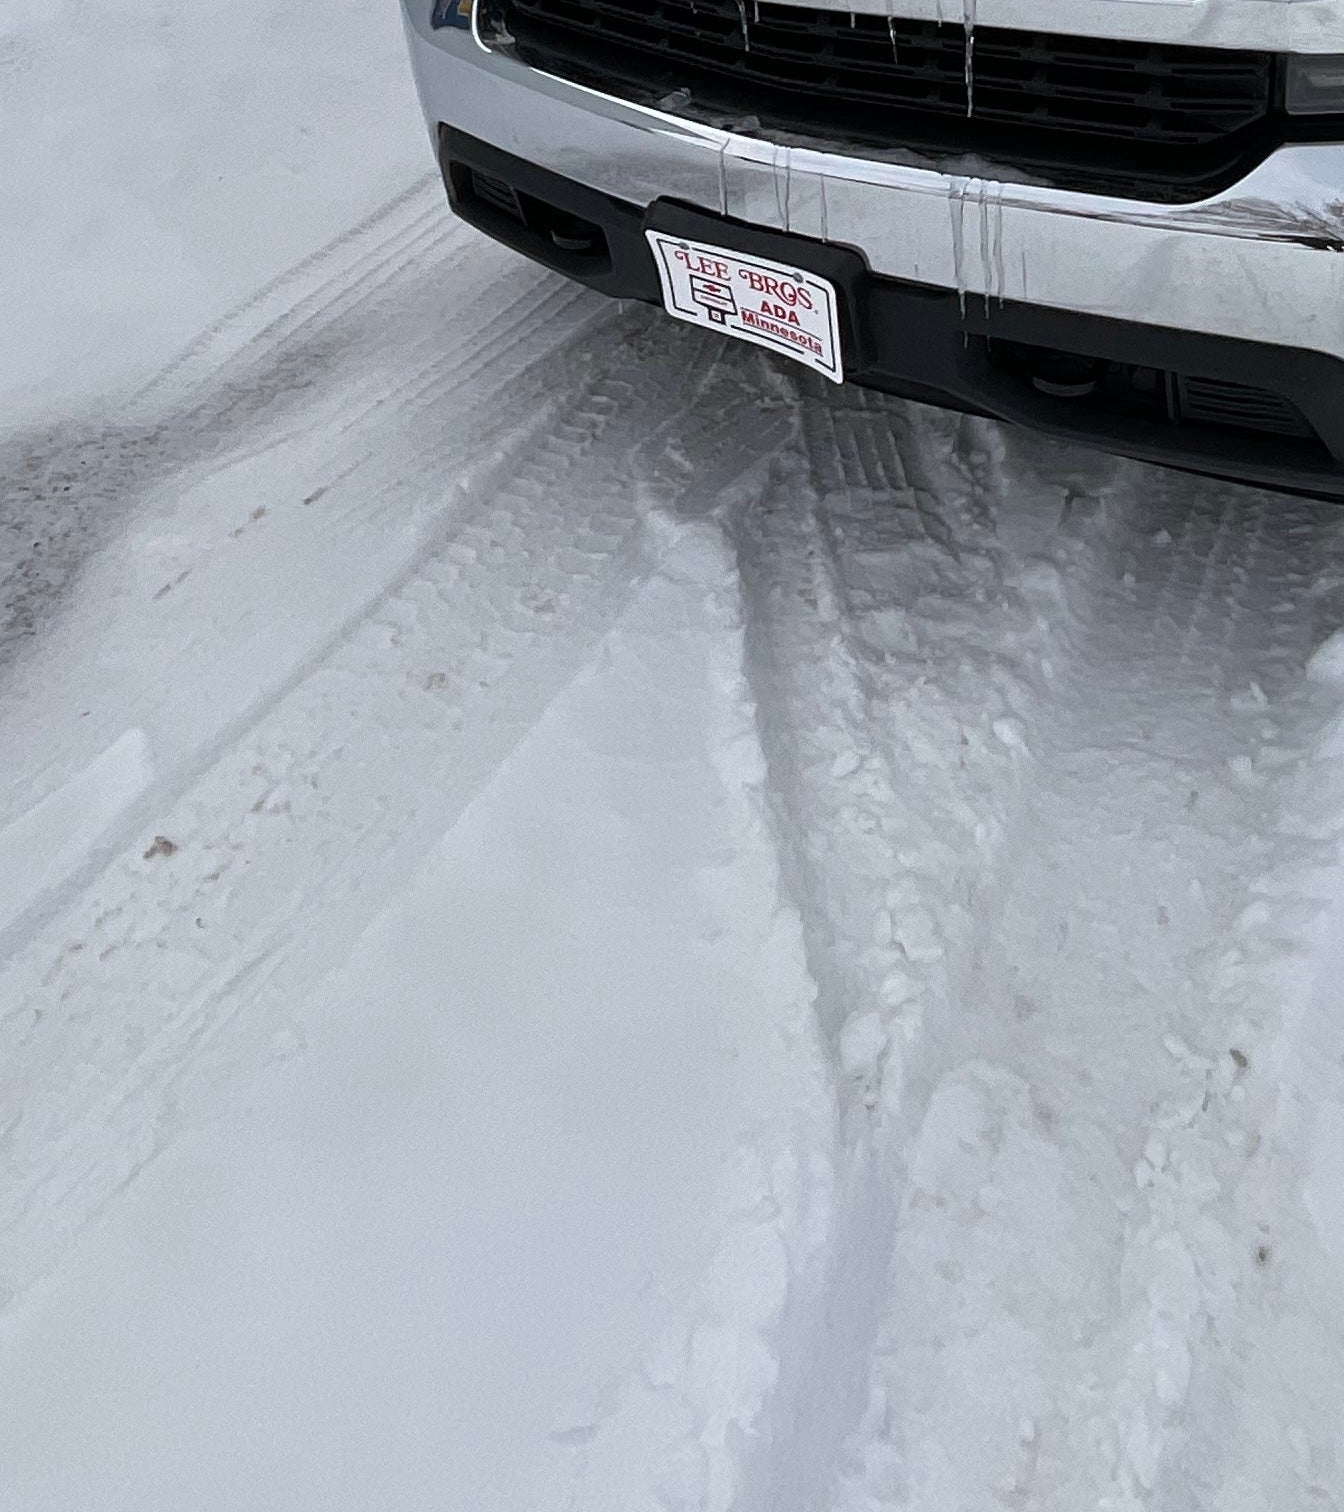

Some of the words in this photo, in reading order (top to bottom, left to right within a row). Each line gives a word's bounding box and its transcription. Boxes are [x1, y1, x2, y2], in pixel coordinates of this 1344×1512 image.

[674, 250, 731, 282] LEE
[760, 300, 801, 326] ADA
[741, 311, 823, 355] Minnesota
